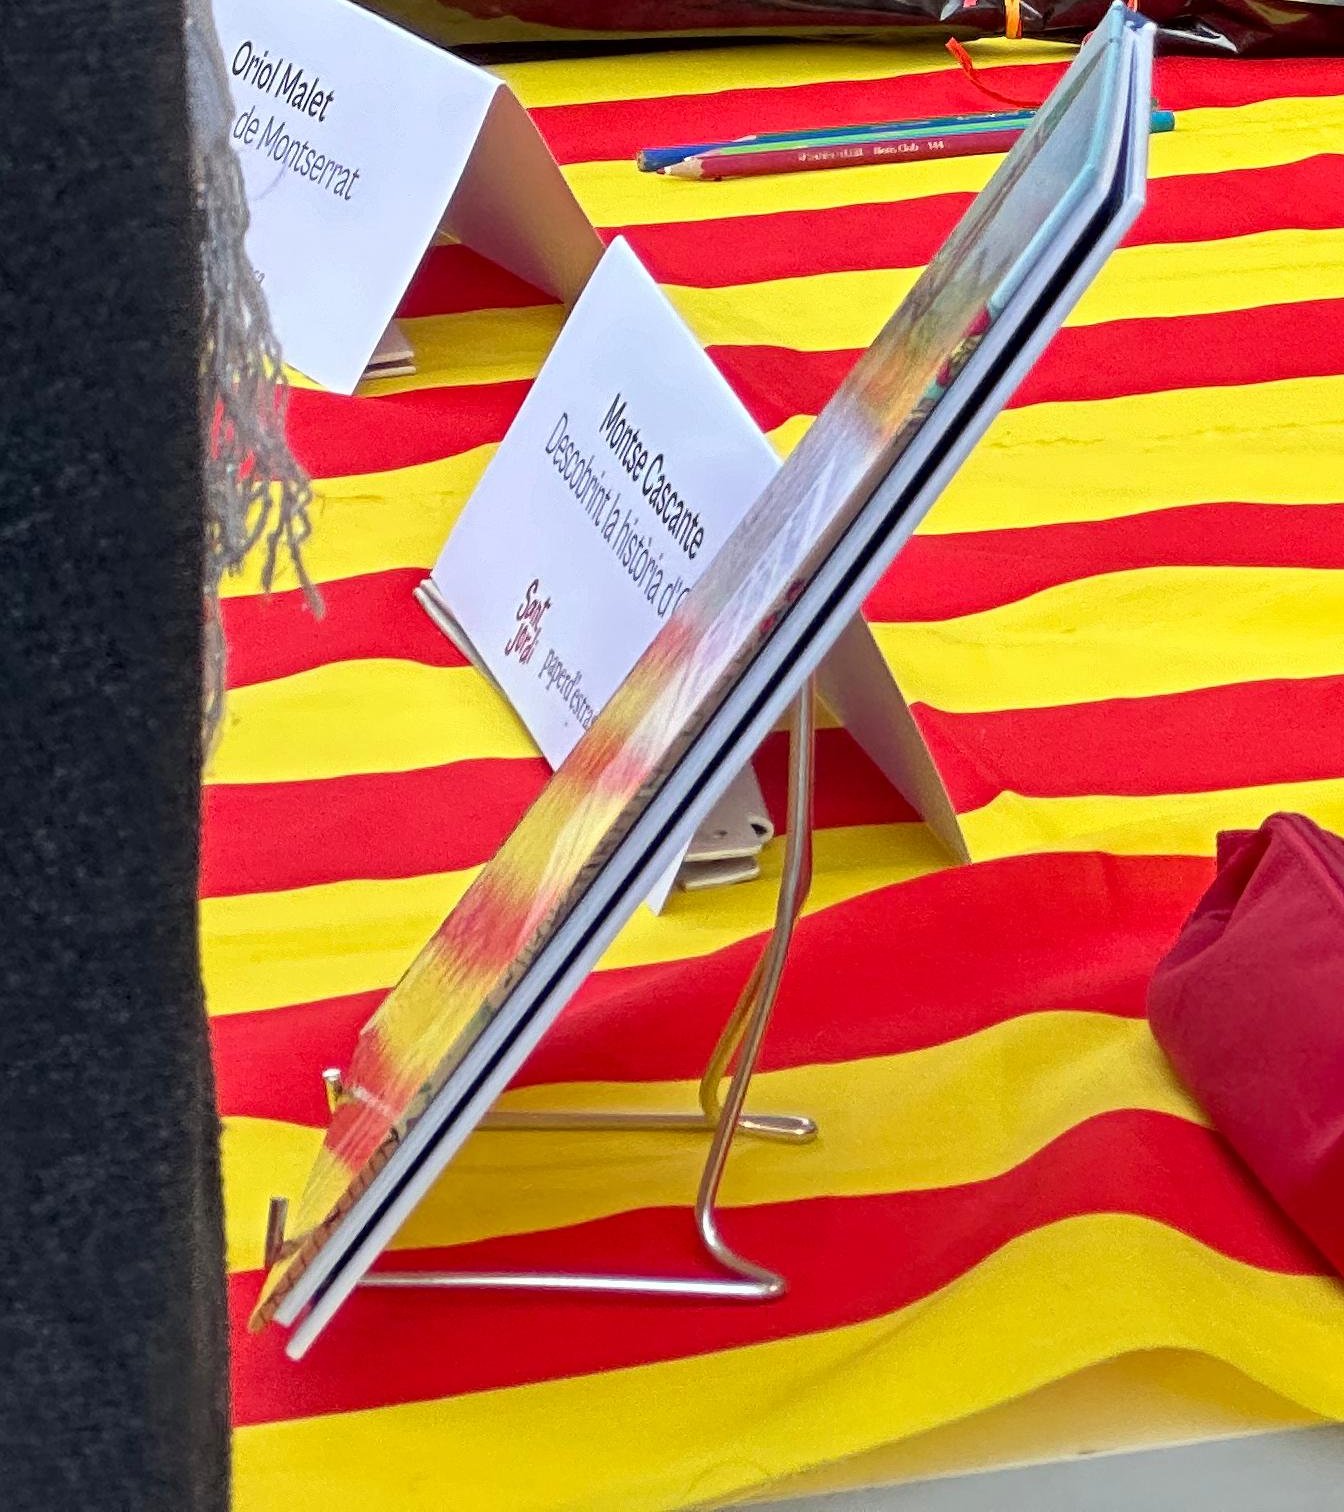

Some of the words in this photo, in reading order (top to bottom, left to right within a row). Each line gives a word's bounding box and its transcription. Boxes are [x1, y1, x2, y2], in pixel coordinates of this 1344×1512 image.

[232, 40, 284, 94] Oriol
[274, 62, 334, 122] Malet
[233, 105, 260, 144] de
[256, 115, 360, 201] Montserrat
[545, 412, 612, 527] Descobrint
[600, 493, 621, 543] la
[611, 509, 666, 605] història
[599, 392, 649, 482] Montse
[641, 453, 704, 561] Cascante
